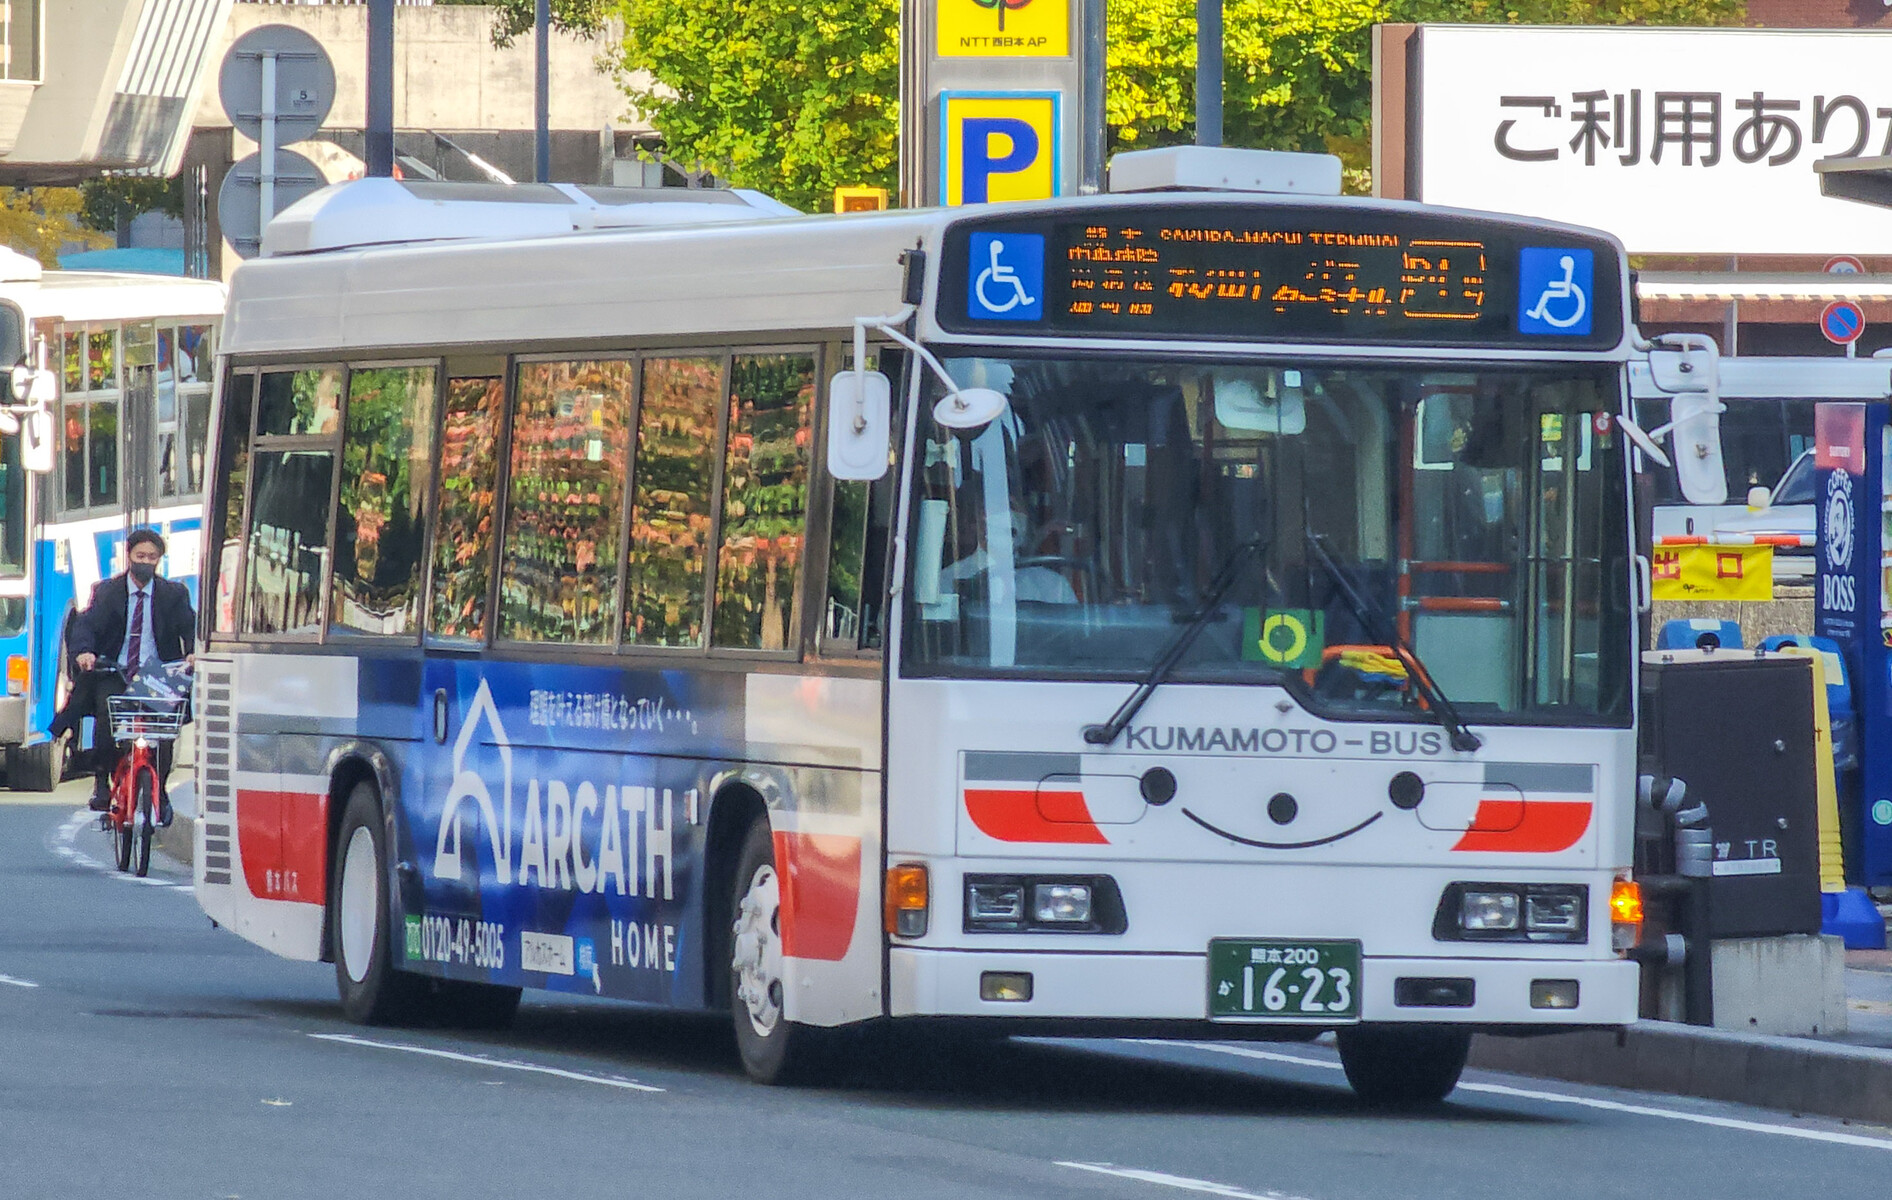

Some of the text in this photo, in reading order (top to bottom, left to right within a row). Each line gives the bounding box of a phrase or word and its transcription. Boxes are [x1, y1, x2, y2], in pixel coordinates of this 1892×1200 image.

[960, 37, 1047, 47] NTT 西日本 AP
[300, 90, 307, 100] 5
[1494, 88, 1892, 167] ご利用あり
[962, 118, 1039, 204] P
[1652, 551, 1743, 580] 出口
[1822, 574, 1856, 612] BOSS
[518, 778, 673, 900] ARCATH
[1744, 839, 1778, 858] TR
[421, 914, 504, 969] 0120-49-5005
[611, 918, 675, 972] HOME
[1251, 947, 1319, 965] 熊本200
[1243, 966, 1352, 1013] 16-23
